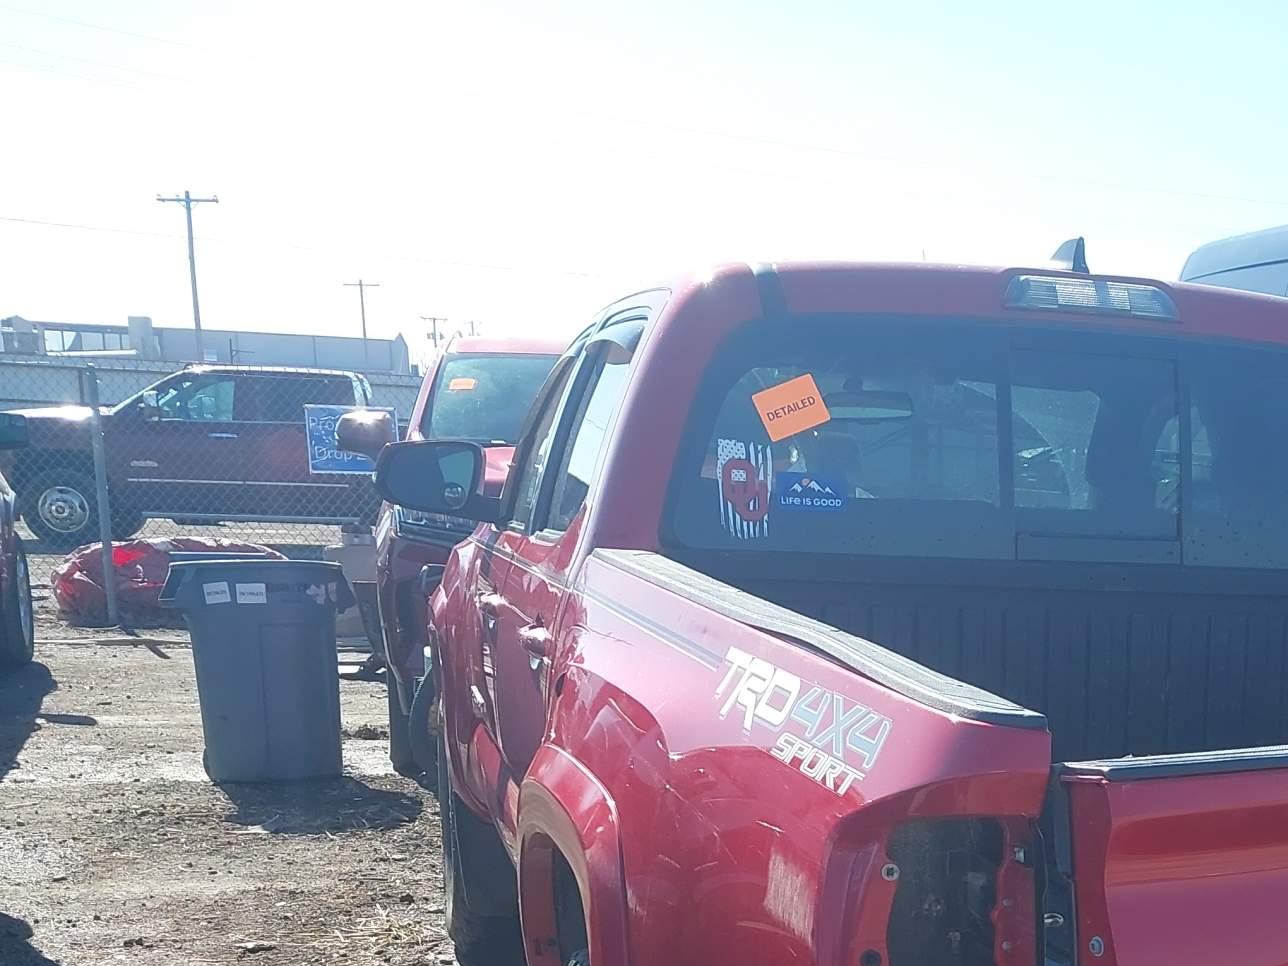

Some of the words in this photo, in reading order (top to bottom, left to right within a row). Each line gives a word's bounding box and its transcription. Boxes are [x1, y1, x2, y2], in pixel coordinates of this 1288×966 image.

[766, 396, 816, 421] DETAILED
[314, 446, 353, 462] Drop
[803, 497, 812, 506] IS
[813, 498, 842, 507] GOOD
[714, 646, 801, 736] TRD
[769, 732, 866, 796] SPORT
